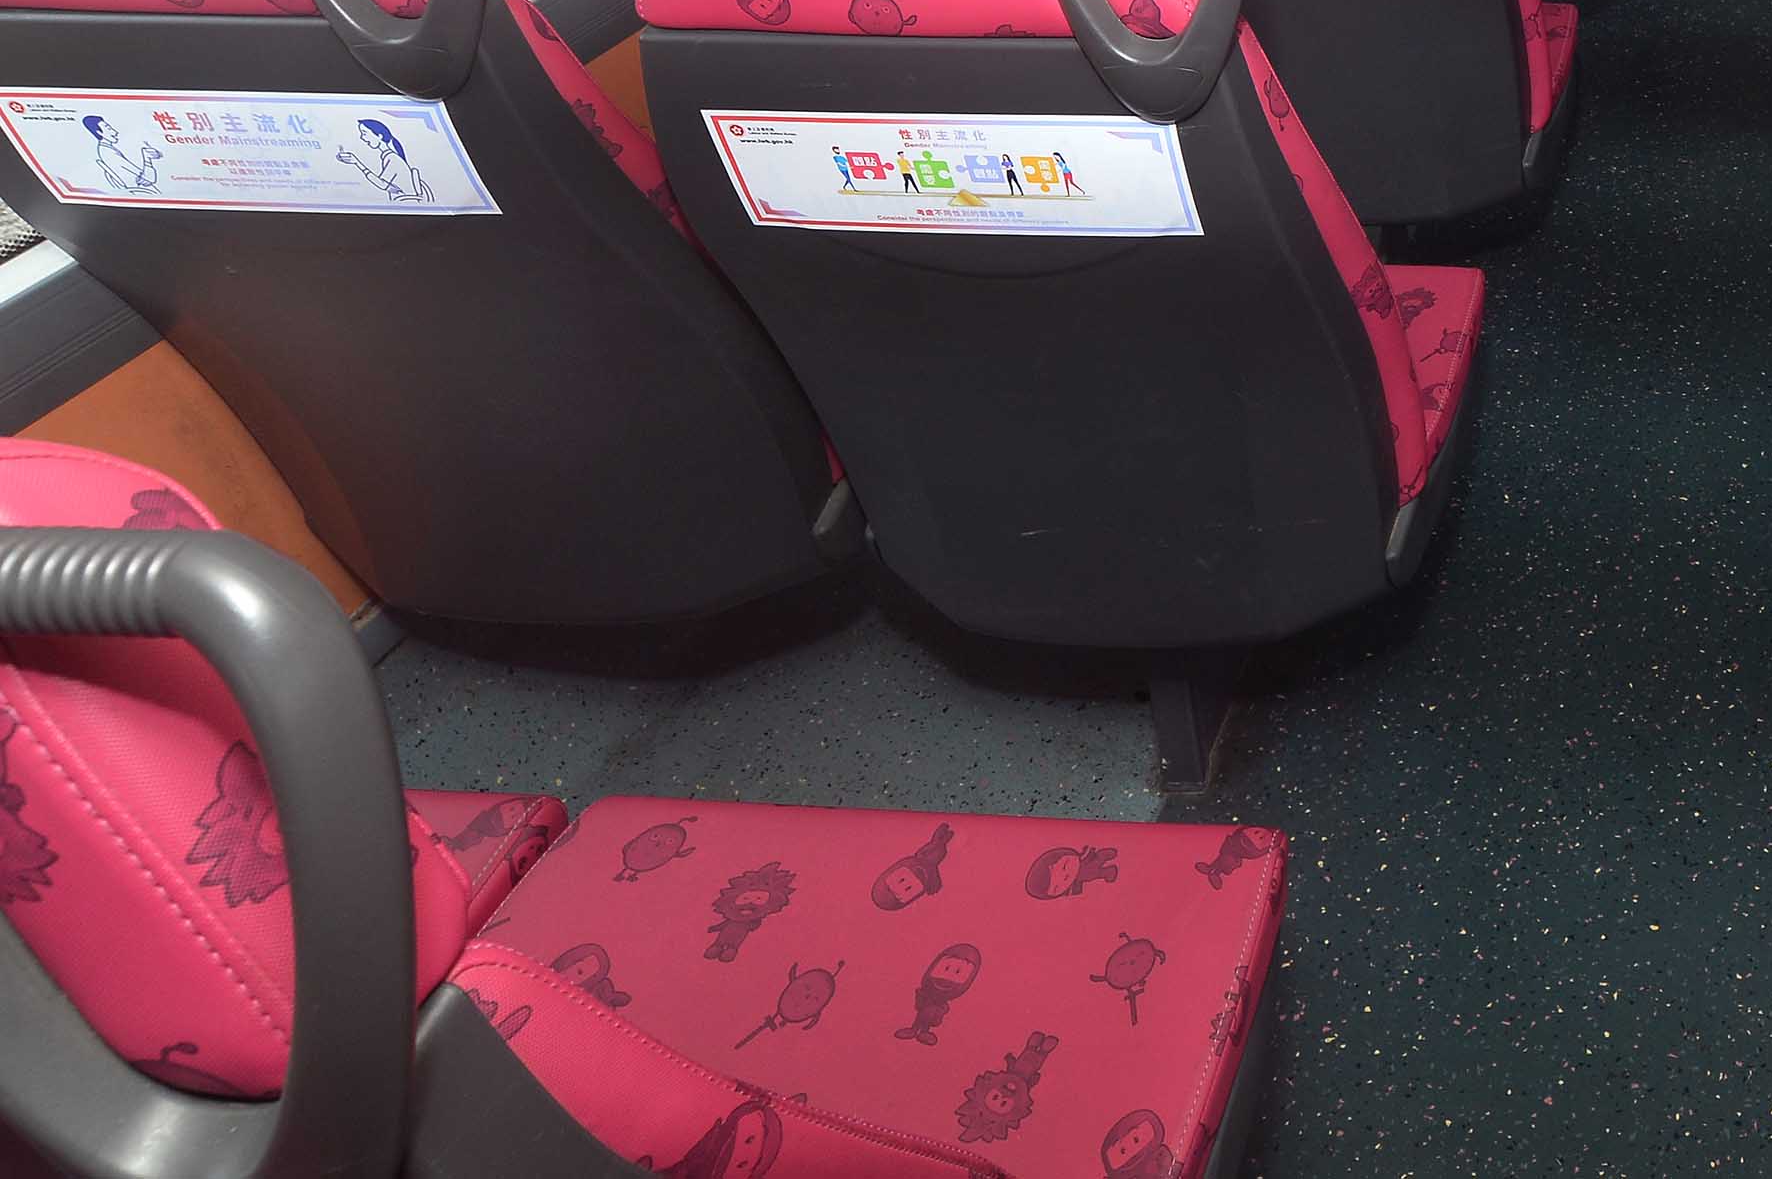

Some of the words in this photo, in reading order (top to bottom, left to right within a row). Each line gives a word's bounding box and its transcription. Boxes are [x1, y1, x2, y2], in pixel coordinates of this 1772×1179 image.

[152, 110, 313, 134] 性別主流化
[164, 134, 216, 146] Gender
[218, 135, 322, 150] Mainstreaming
[898, 128, 987, 141] 性別主流化
